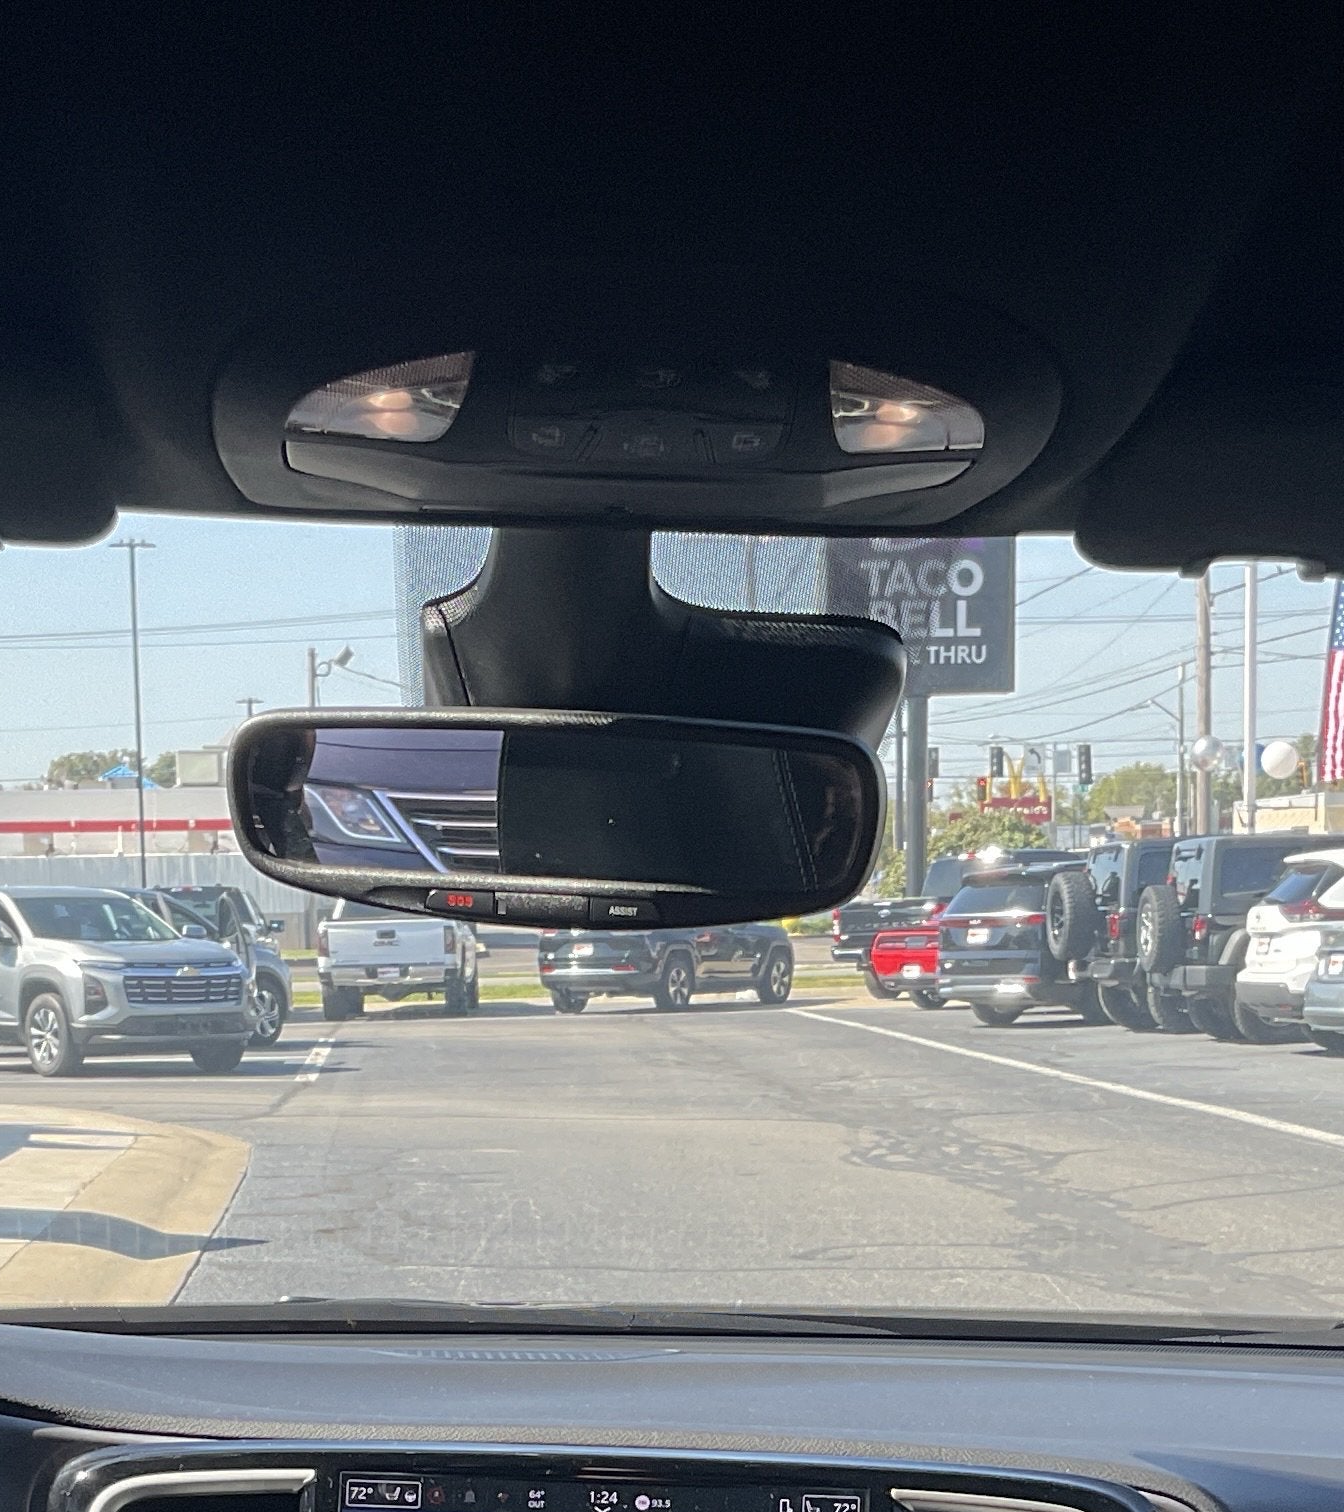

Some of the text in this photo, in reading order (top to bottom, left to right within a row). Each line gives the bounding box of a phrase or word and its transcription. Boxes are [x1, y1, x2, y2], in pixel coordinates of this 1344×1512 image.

[860, 559, 984, 597] TACO
[926, 645, 987, 665] THRU
[606, 905, 639, 917] ASSIST
[349, 1486, 374, 1501] 72°
[589, 1490, 619, 1505] 1:24
[527, 1500, 546, 1509] OUT
